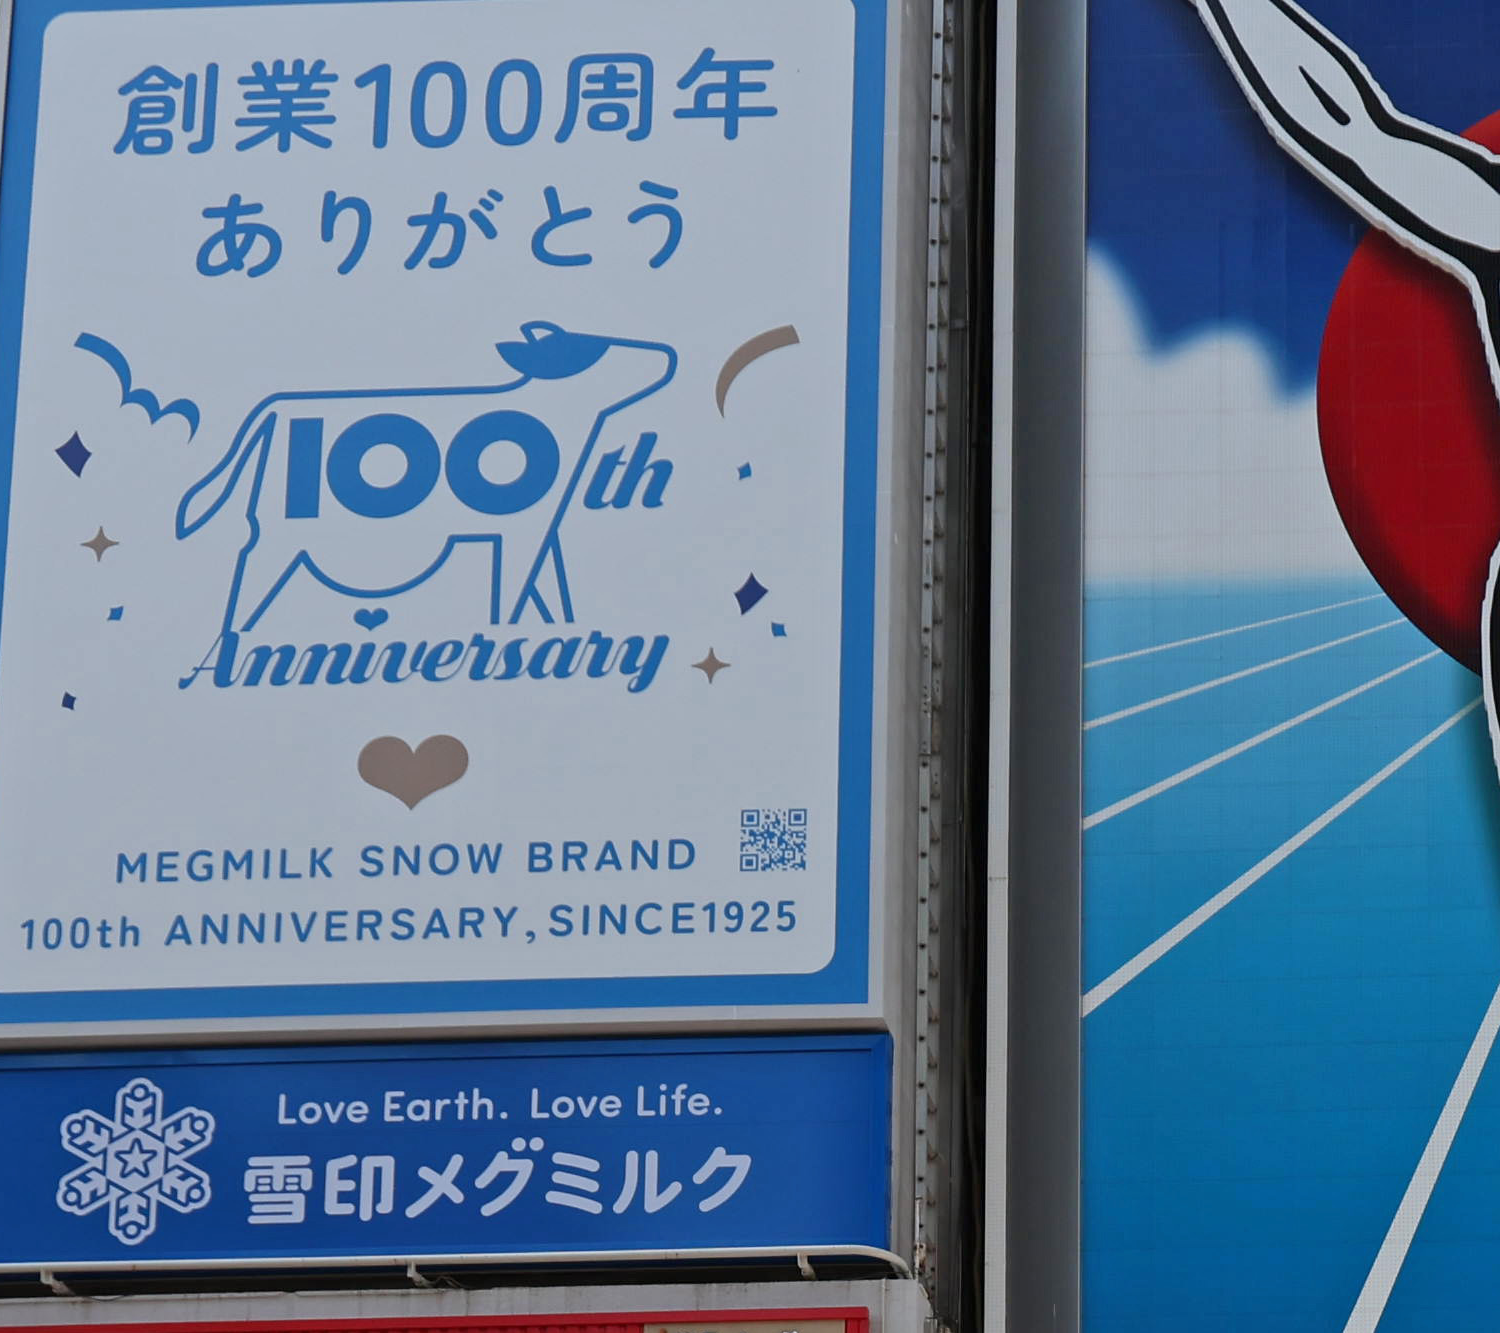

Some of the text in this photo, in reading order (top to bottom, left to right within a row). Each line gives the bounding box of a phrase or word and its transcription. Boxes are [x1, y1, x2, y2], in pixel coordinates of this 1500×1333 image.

[113, 47, 778, 156] 創業100周年
[195, 180, 684, 278] ありがとう
[285, 410, 673, 519] 100th
[179, 627, 668, 692] Anniversary
[115, 837, 696, 884] MEGMILK SNOW BRAND
[20, 914, 142, 952] 100th
[278, 1082, 723, 1126] Love Earth. Love Life.
[244, 1137, 752, 1225] 雪印メグミルク
